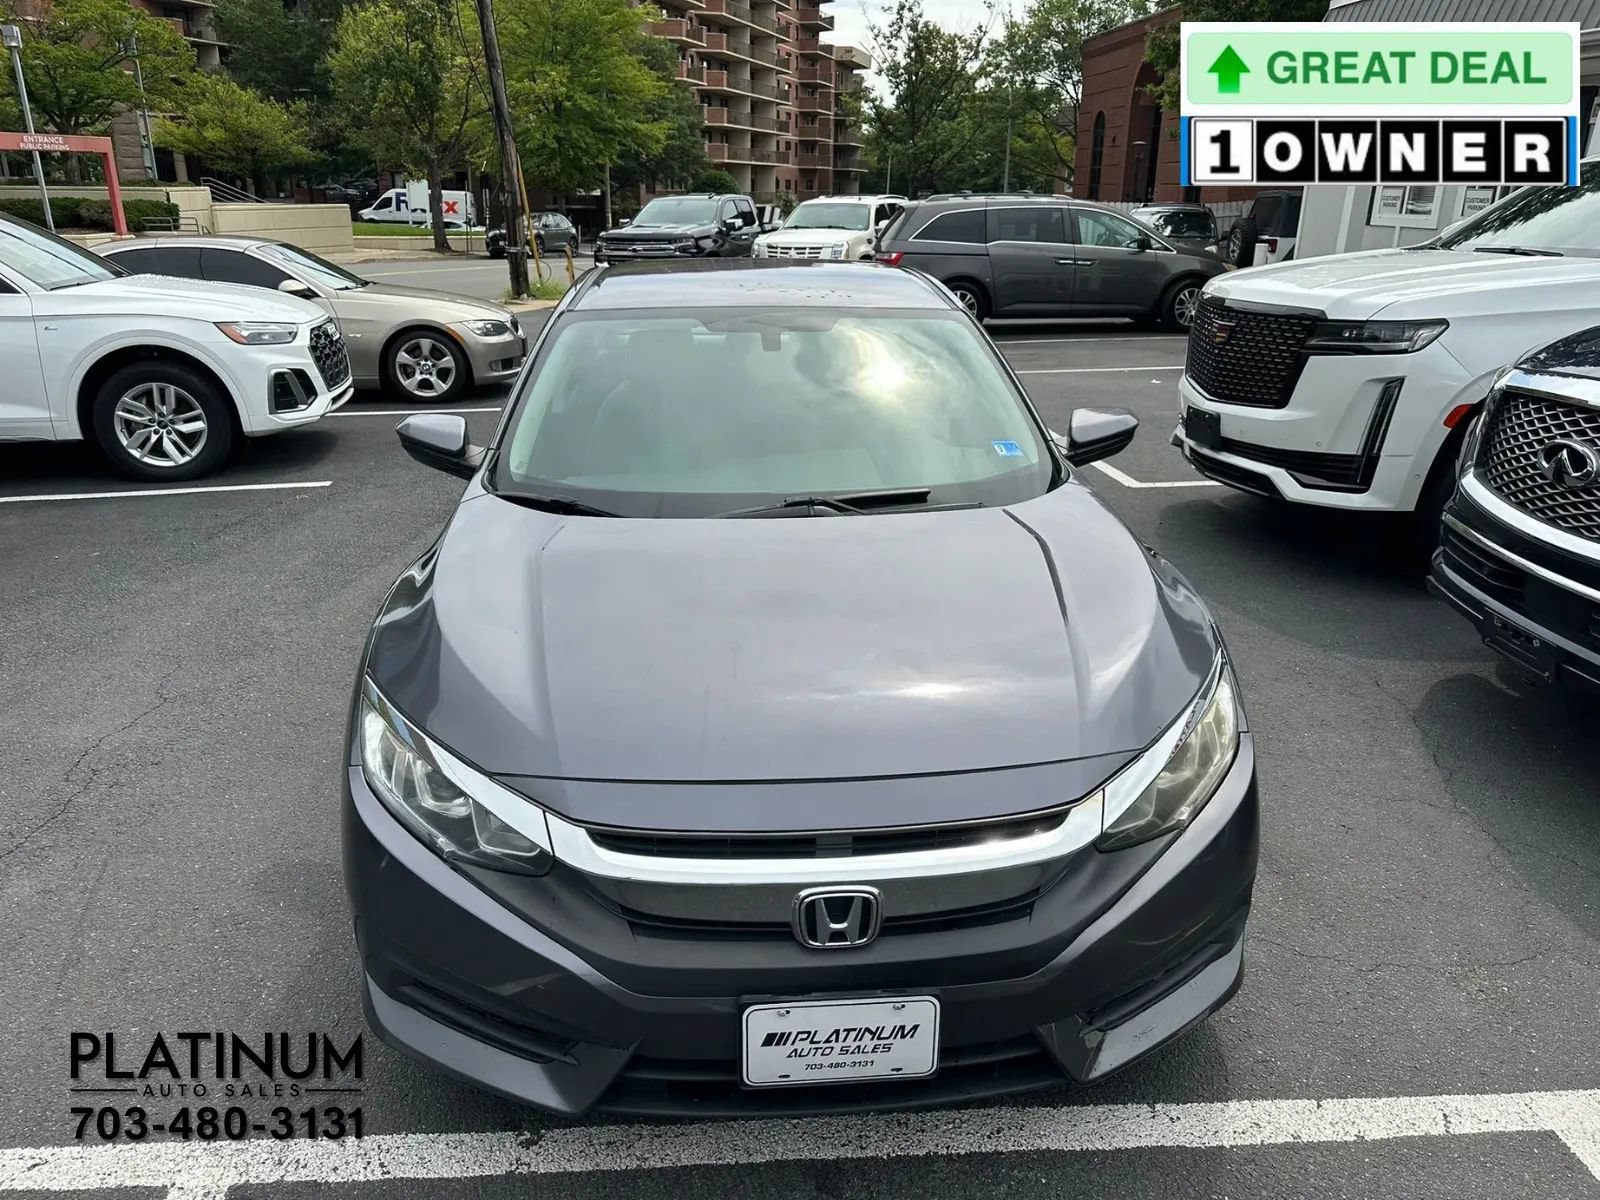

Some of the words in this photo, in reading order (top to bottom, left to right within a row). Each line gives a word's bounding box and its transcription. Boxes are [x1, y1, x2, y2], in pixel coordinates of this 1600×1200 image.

[23, 135, 64, 144] ENTRANCE
[43, 143, 70, 151] PARKING
[790, 1023, 921, 1046] PLATINUM
[786, 1046, 834, 1059] AUTO
[838, 1043, 894, 1056] SALES
[804, 1060, 875, 1071] 703-480-3131
